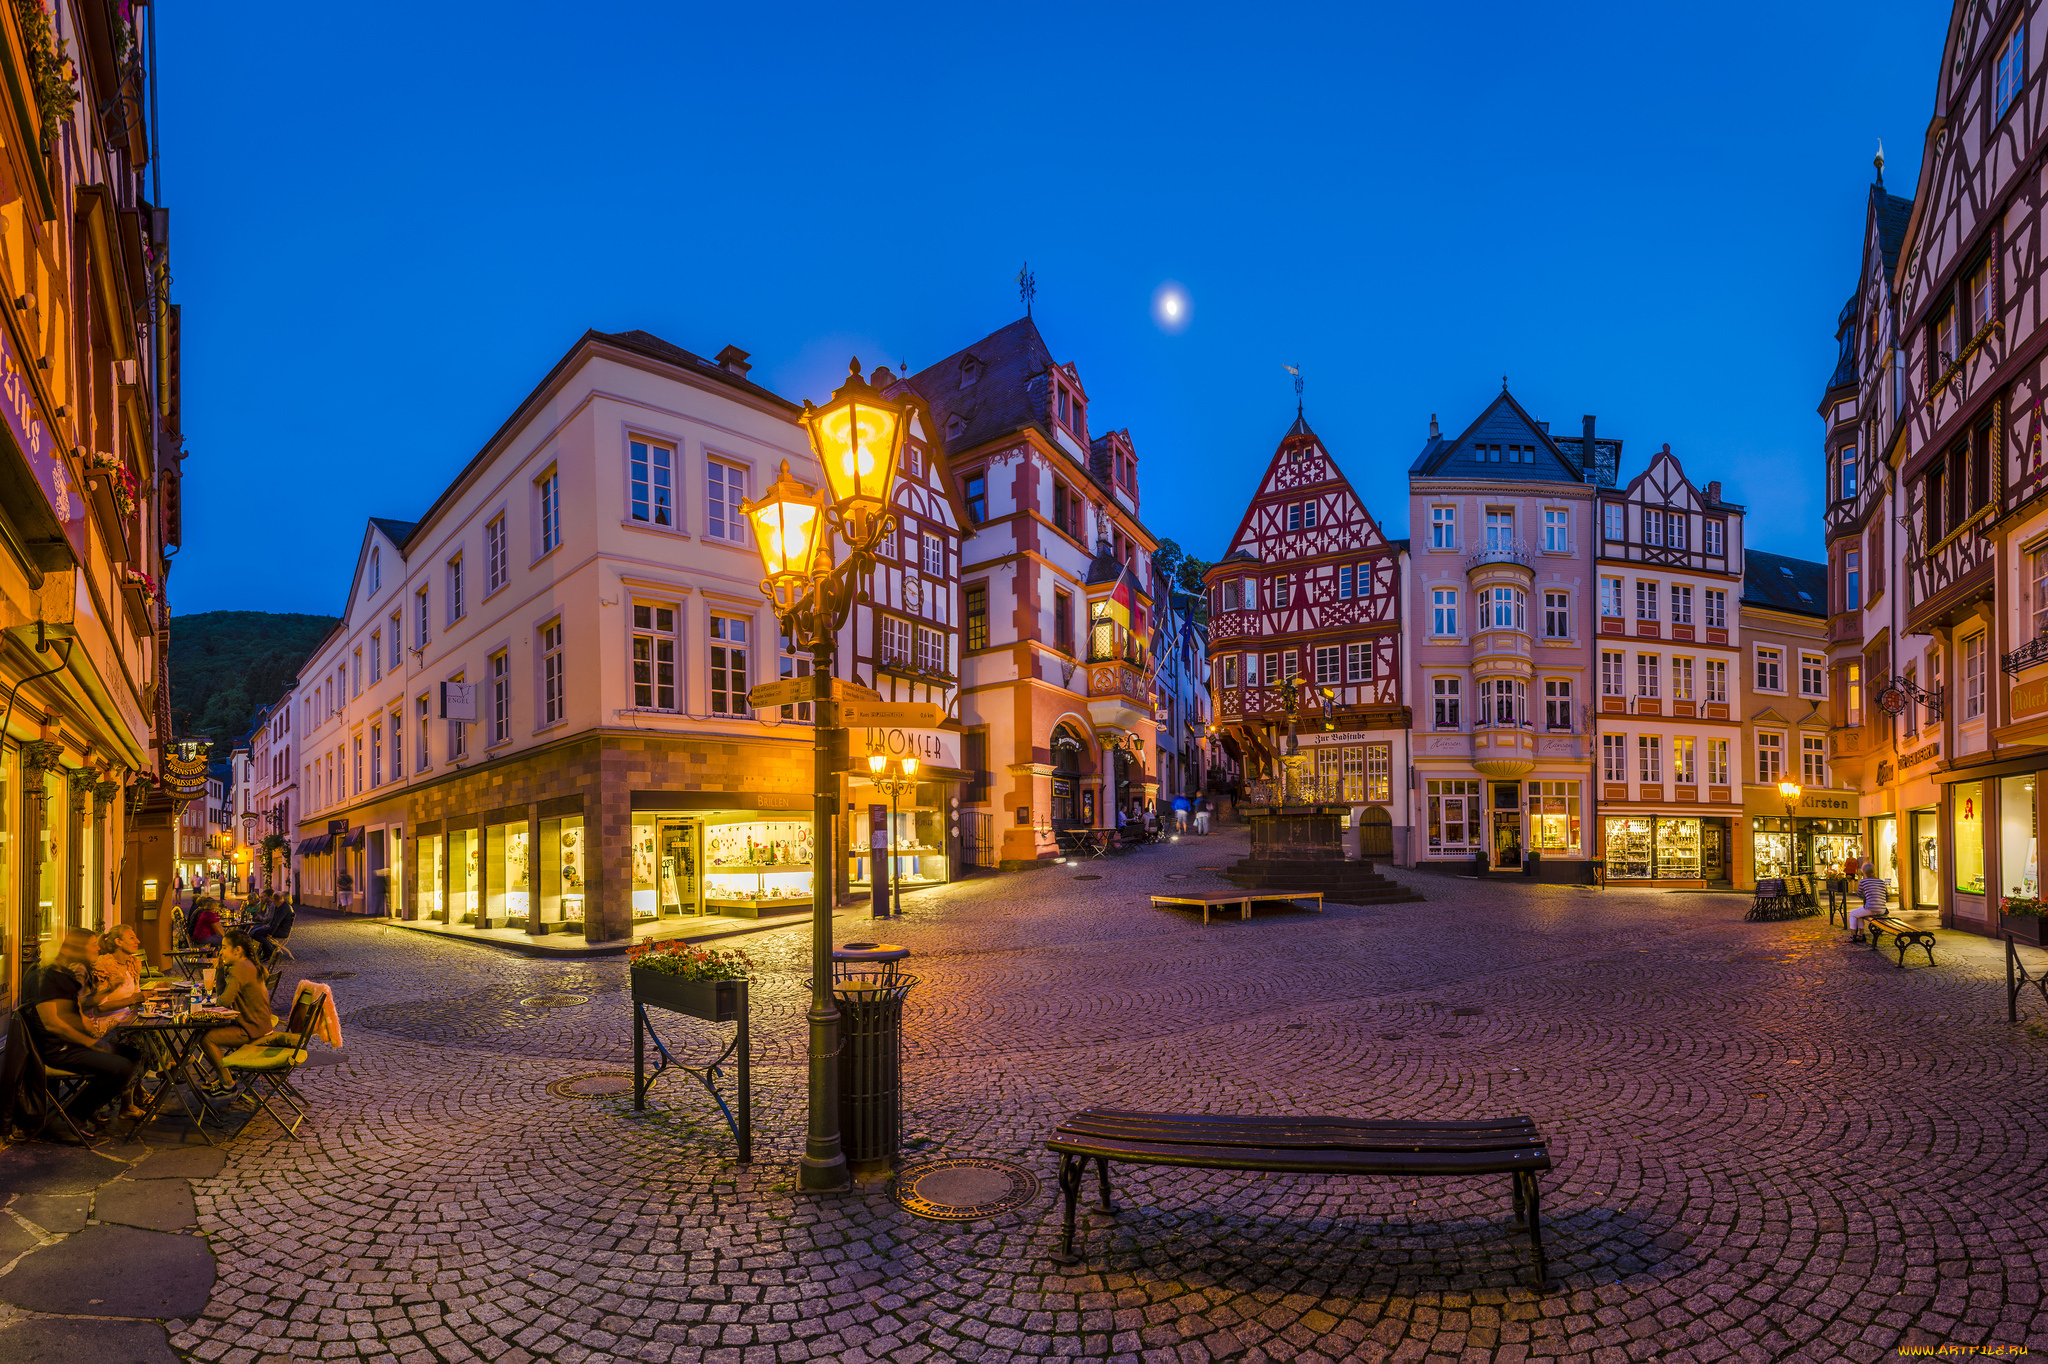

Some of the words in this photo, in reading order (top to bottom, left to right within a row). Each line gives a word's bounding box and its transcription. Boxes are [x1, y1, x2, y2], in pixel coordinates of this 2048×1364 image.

[2013, 687, 2041, 713] Adler
[1315, 734, 1329, 744] Zur
[1431, 737, 1462, 750] Hansen
[1543, 738, 1573, 751] Hansen
[168, 762, 206, 775] WEINSTUBE
[1802, 796, 1849, 809] Kirsten
